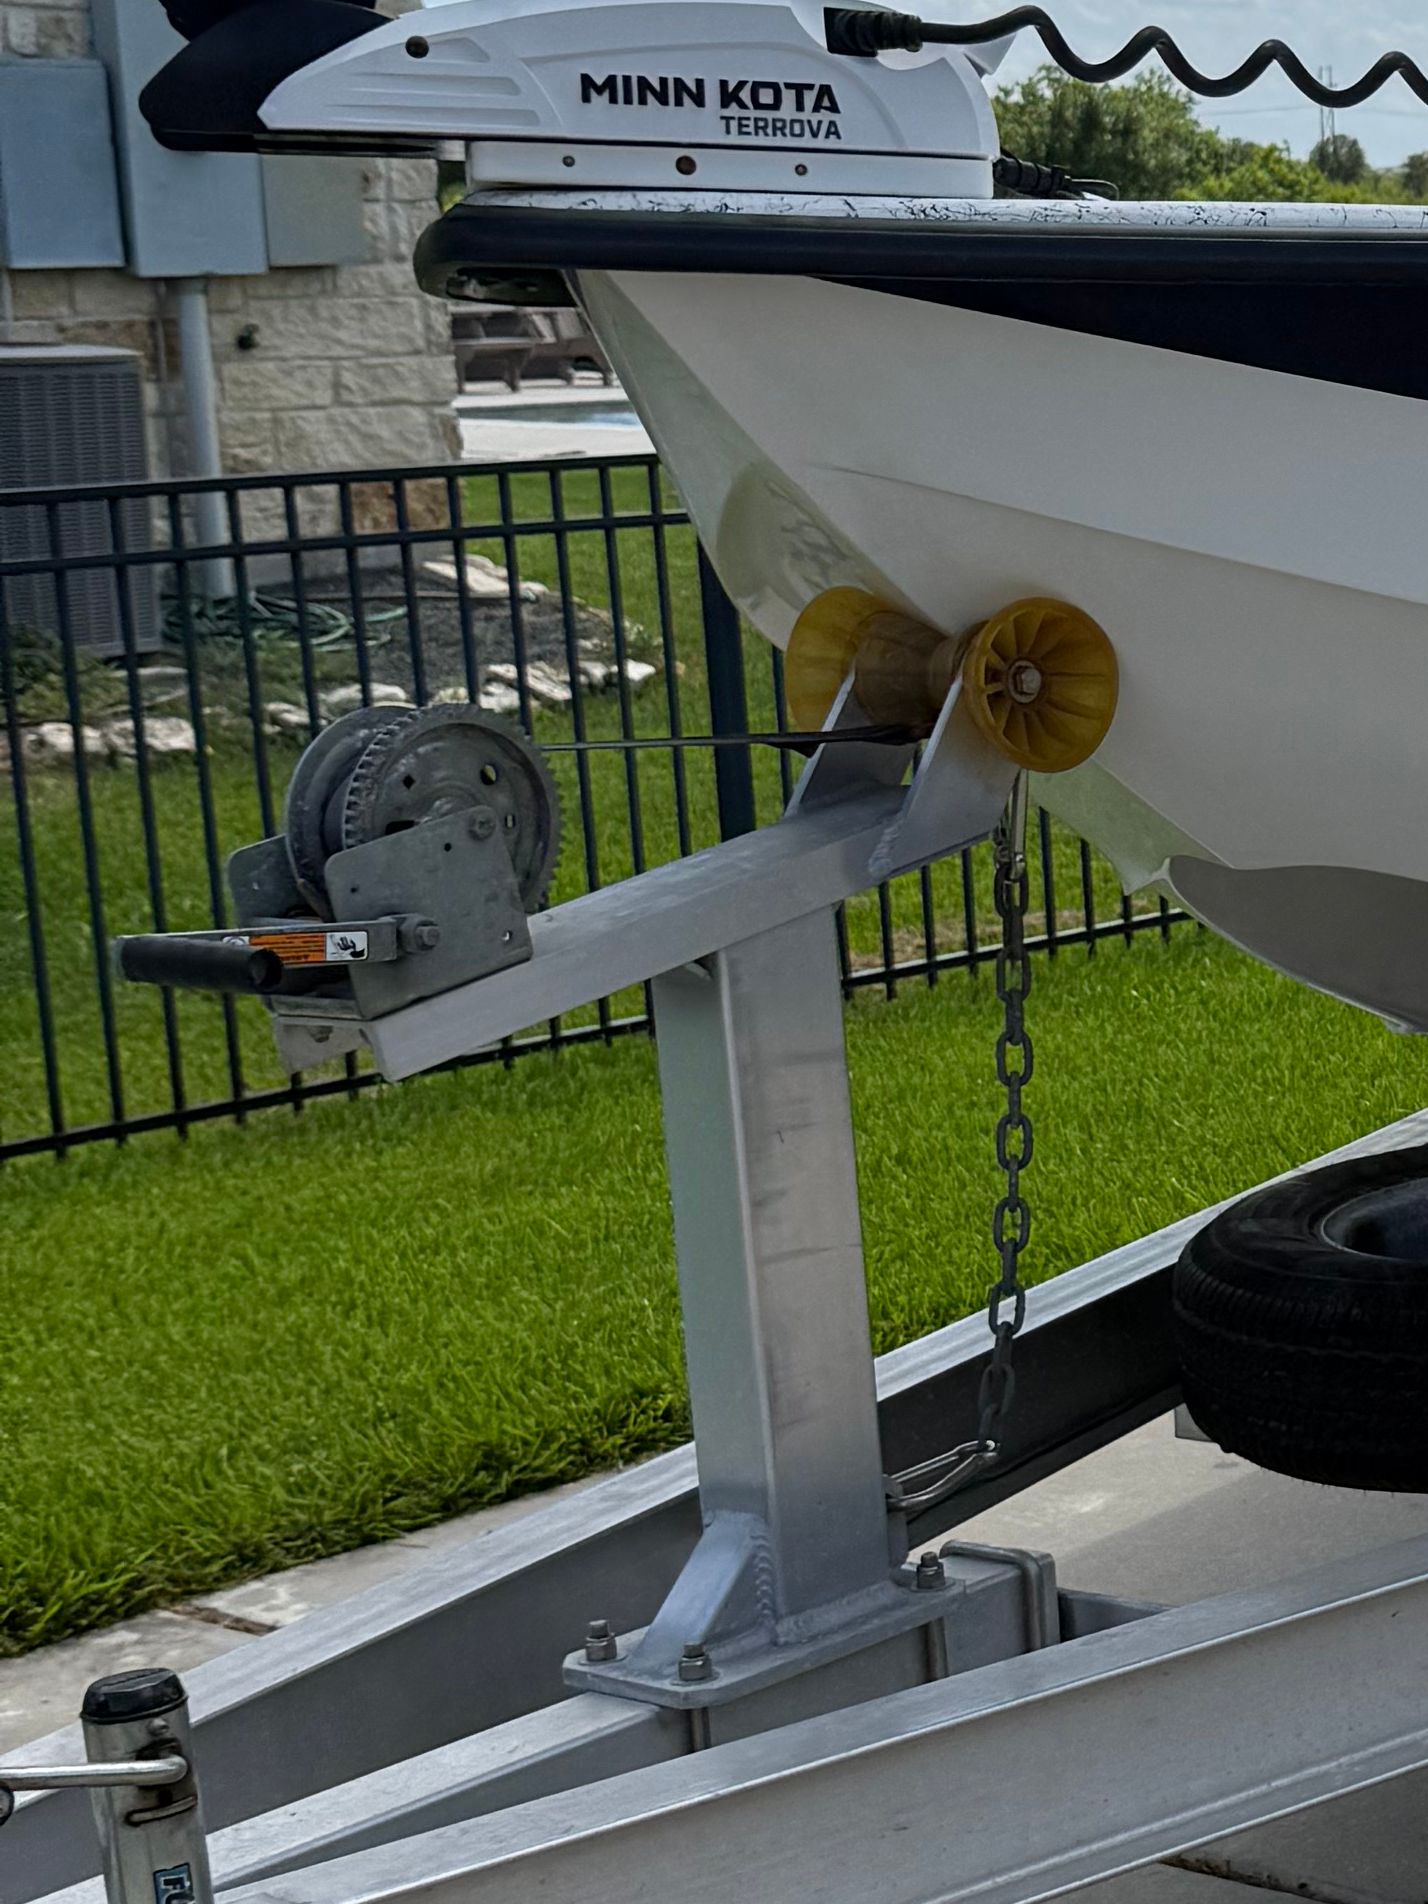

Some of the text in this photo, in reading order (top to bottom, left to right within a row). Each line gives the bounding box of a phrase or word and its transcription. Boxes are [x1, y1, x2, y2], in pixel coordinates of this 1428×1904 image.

[580, 73, 841, 114] MINN KOTA
[720, 116, 841, 140] TERROVA
